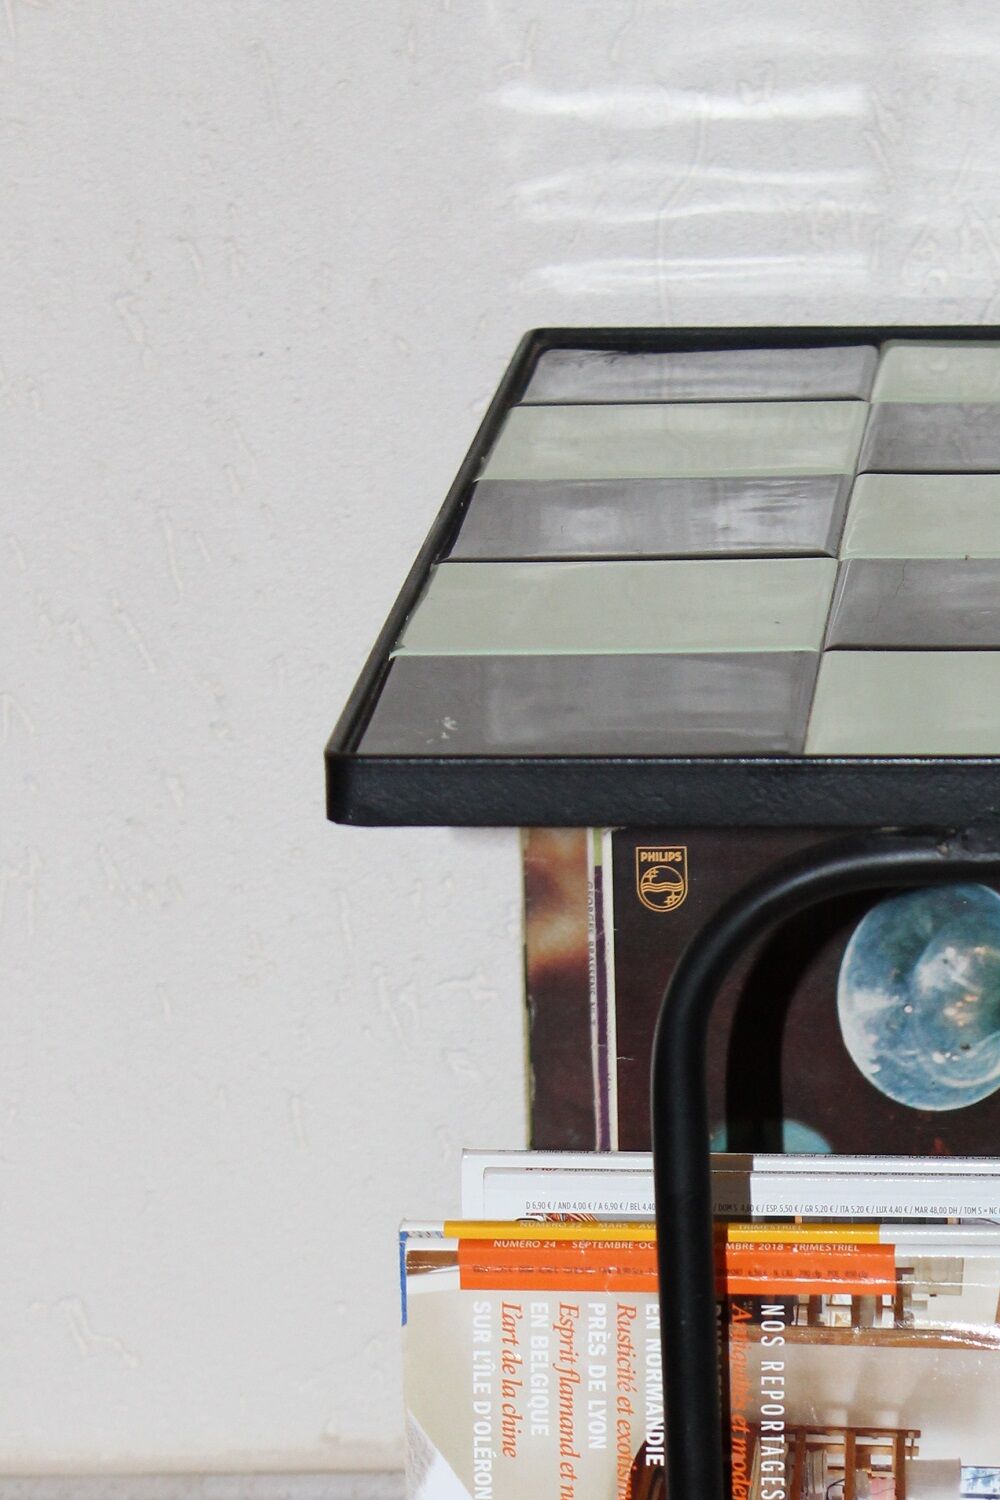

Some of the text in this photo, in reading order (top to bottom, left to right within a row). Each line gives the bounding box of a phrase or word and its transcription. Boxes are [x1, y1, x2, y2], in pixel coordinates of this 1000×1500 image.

[640, 851, 683, 862] PHILIPS
[571, 1240, 655, 1249] SEPTEMBRE-OC
[758, 1243, 784, 1251] 2018
[791, 1243, 860, 1252] TRIMESTRIEL
[630, 1202, 641, 1211] BEL
[876, 1205, 887, 1214] LUX
[915, 1206, 929, 1215] MAR
[964, 1206, 976, 1215] TOM
[527, 1301, 550, 1437] EN BELGIQUE
[552, 1302, 580, 1364] Esprit
[587, 1302, 609, 1449] PRÈS DE LYON
[616, 1303, 637, 1393] Rusticité
[473, 1301, 497, 1500] SUR L'ÎLE D'OLÉRON
[501, 1302, 523, 1458] L'art de la chine
[552, 1363, 581, 1459] flamand
[616, 1398, 635, 1416] et
[645, 1303, 664, 1467] EN NORMANDIE
[732, 1413, 750, 1433] et
[760, 1303, 785, 1500] NOS REPORTAGES
[559, 1461, 579, 1479] et
